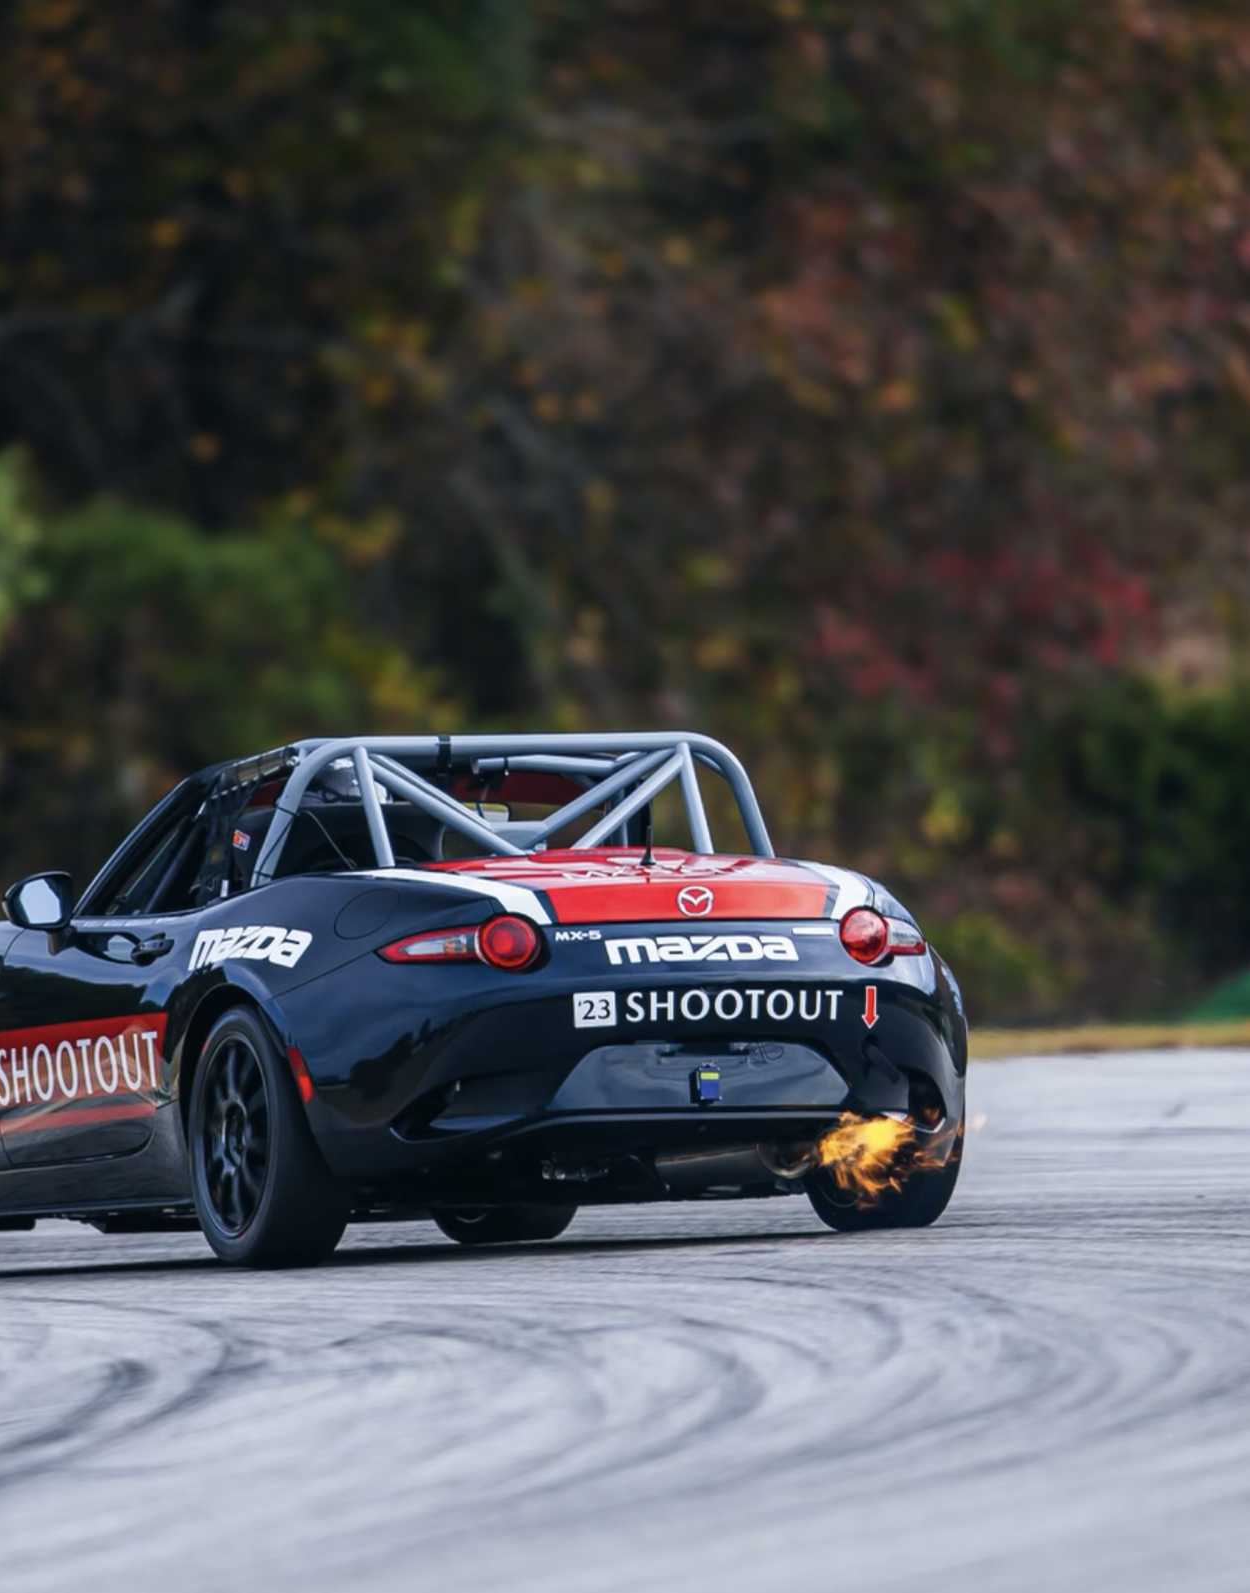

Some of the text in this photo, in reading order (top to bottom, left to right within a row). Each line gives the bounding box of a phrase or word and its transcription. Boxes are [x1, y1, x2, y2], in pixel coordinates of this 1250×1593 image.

[555, 930, 602, 941] MX-5
[578, 989, 843, 1022] '23 SHOOTOUT
